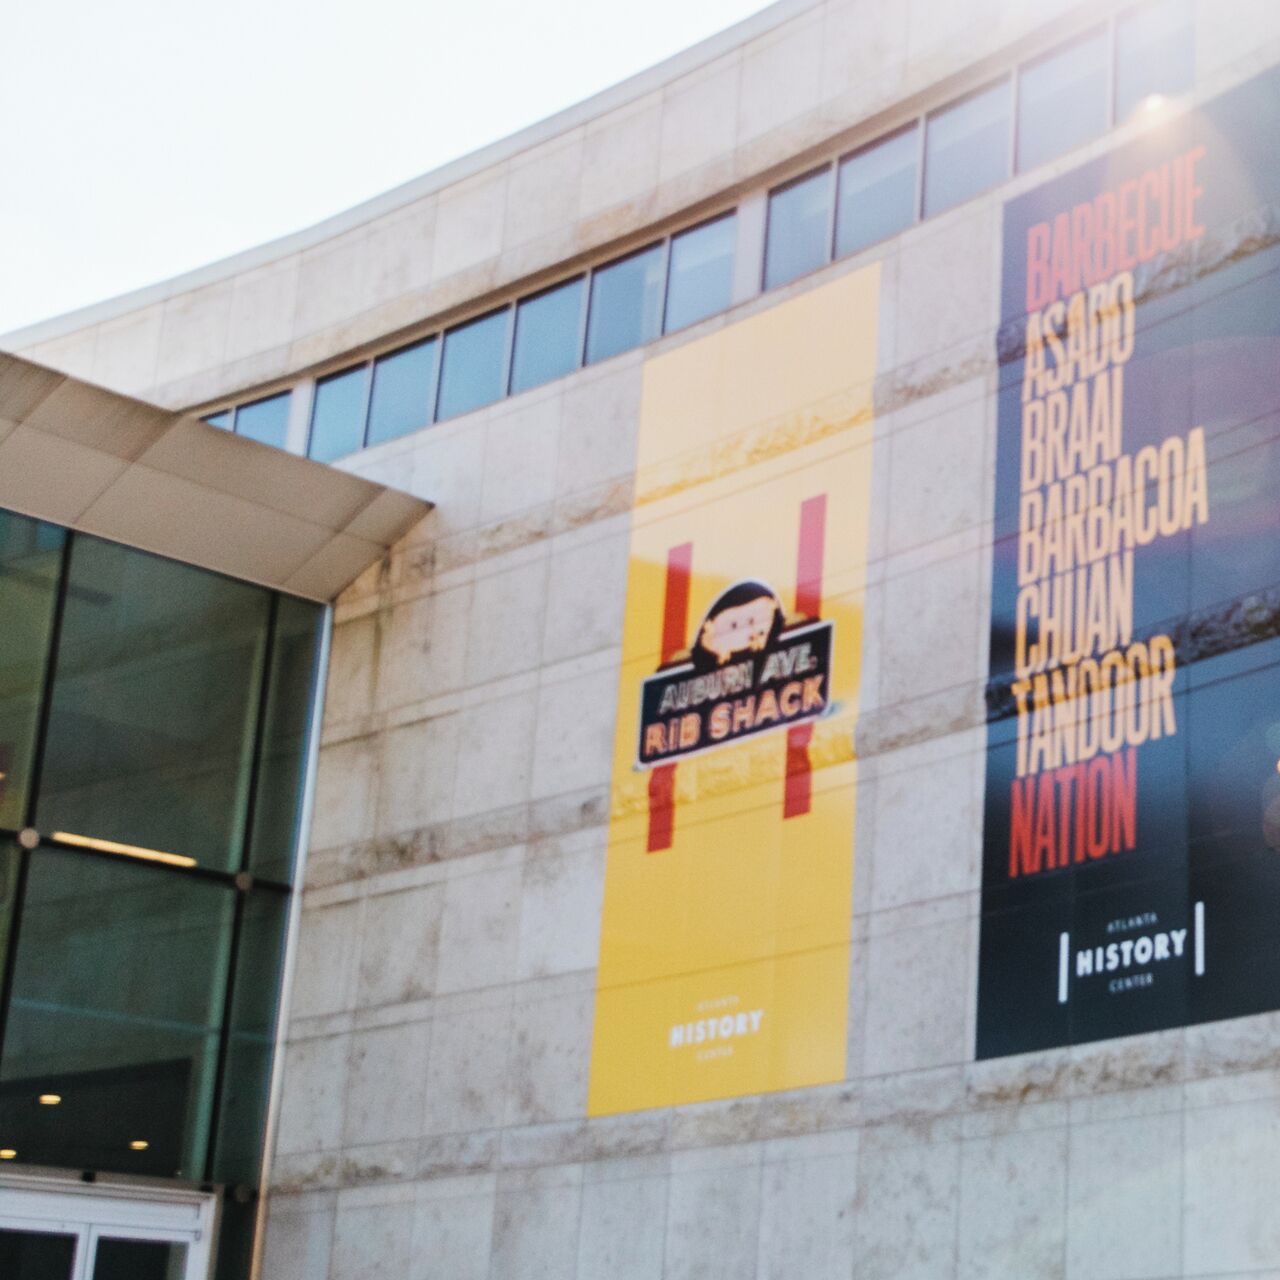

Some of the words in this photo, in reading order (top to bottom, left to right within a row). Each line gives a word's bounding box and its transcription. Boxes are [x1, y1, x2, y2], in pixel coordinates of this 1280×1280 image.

[1027, 146, 1205, 313] BARBECUE
[1023, 271, 1135, 403] ASADO
[1020, 366, 1123, 493] BRAAI
[1018, 426, 1208, 587] BARBACOA
[1015, 548, 1133, 680] CHUAN
[645, 712, 700, 757] RIB
[709, 674, 825, 740] SHACK
[660, 661, 753, 712] AUBURN
[1012, 635, 1176, 777] TANDOOR
[1009, 746, 1136, 878] NATION
[1076, 928, 1187, 977] HISTORY
[1107, 912, 1157, 933] ATLANTA
[1109, 973, 1153, 993] CENTER
[669, 1008, 764, 1048] HISTORY
